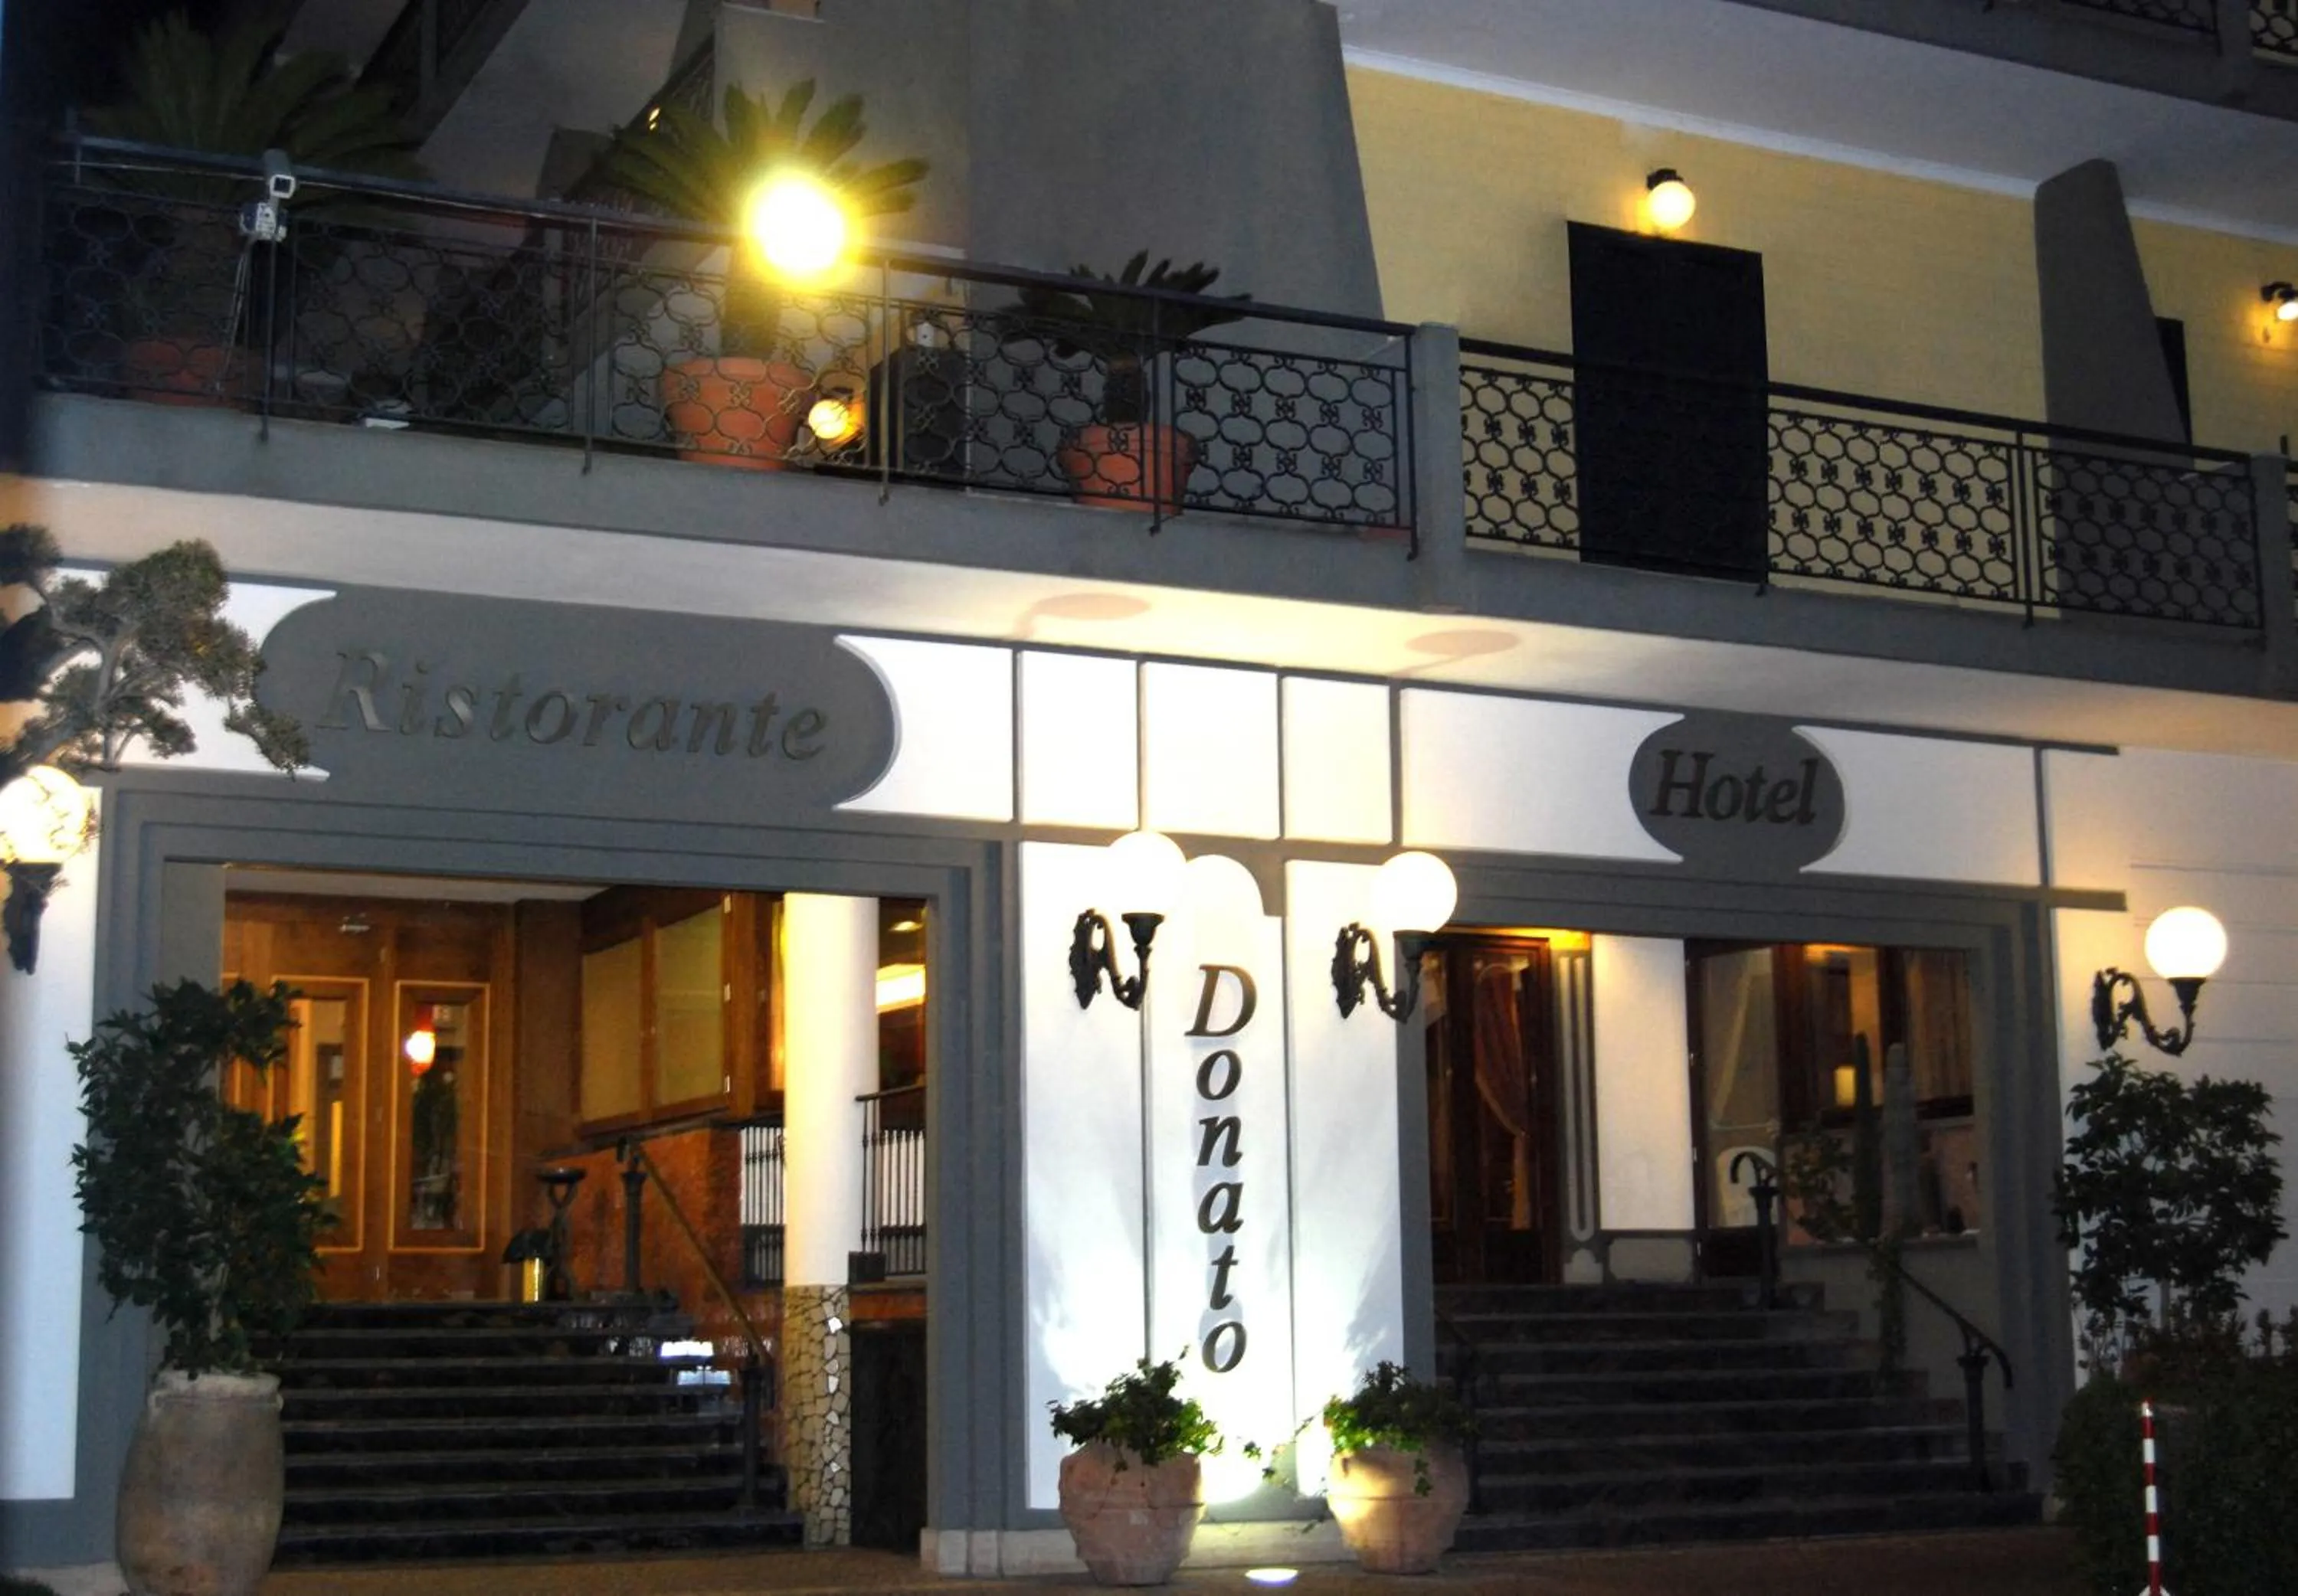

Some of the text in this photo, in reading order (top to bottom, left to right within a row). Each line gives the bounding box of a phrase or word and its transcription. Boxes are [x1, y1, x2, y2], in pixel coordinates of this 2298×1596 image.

[315, 647, 829, 760] Ristorante
[1648, 749, 1819, 825] Hotel
[1184, 963, 1257, 1373] Donato
